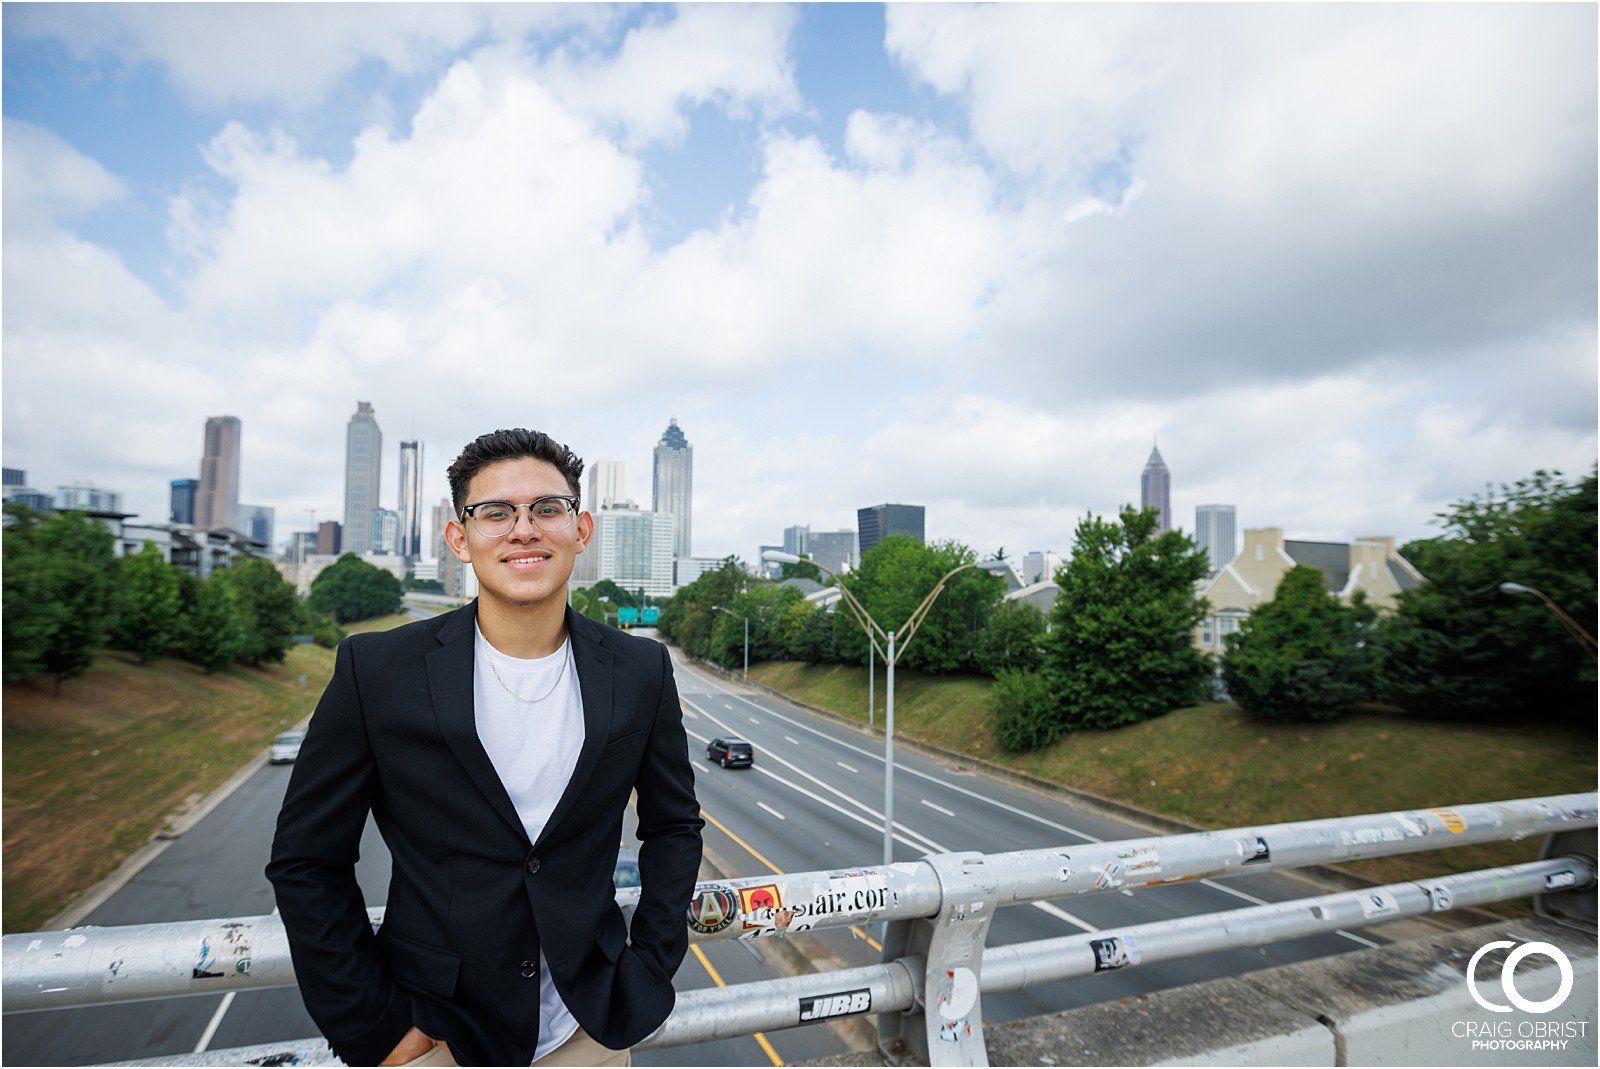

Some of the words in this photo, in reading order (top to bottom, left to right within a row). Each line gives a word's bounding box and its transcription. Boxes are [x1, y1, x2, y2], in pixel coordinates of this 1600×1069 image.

[699, 892, 725, 925] A
[692, 922, 708, 932] FOR
[710, 918, 732, 931] Y'ALL
[800, 992, 870, 1020] JIBB
